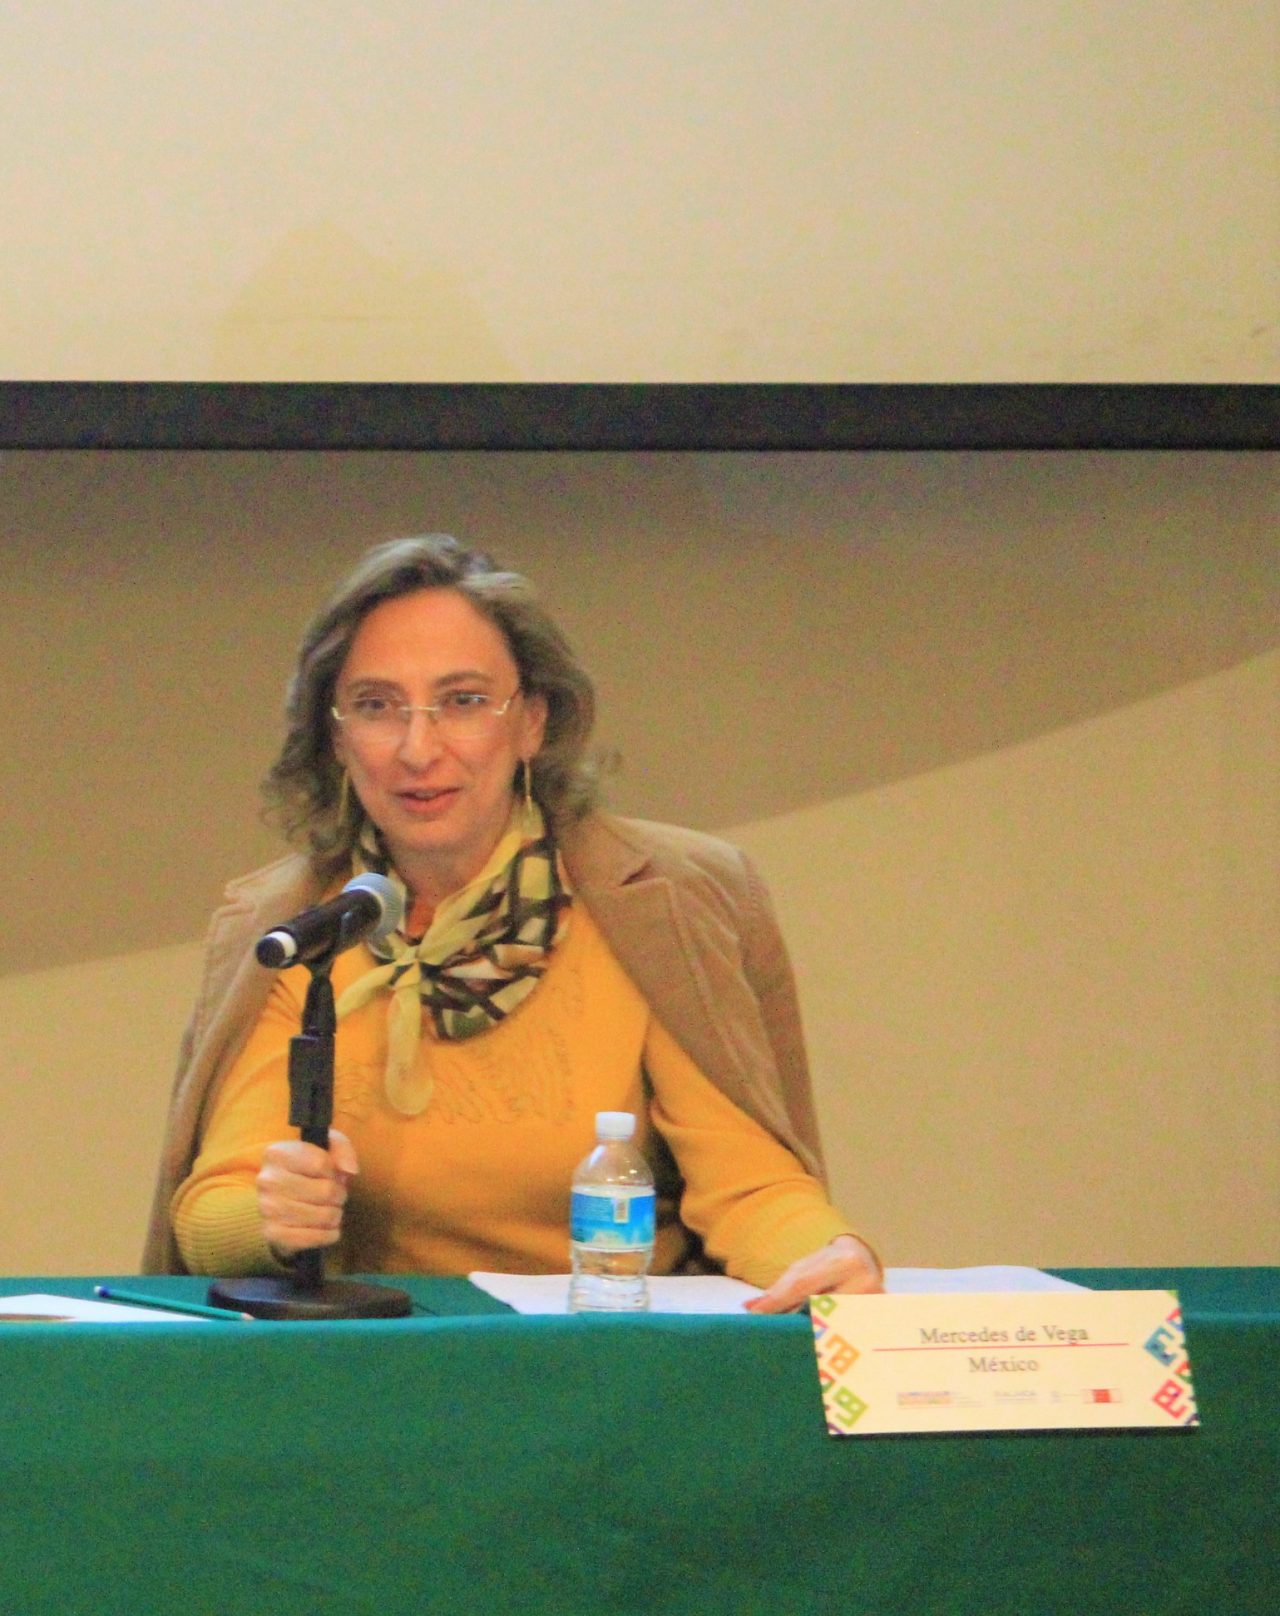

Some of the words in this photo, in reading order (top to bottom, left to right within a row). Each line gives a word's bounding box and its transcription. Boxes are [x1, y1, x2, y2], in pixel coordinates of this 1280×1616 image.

[919, 1327, 1009, 1344] Mercedes
[1015, 1326, 1037, 1342] de
[1042, 1324, 1089, 1346] Vega
[968, 1355, 1039, 1373] México
